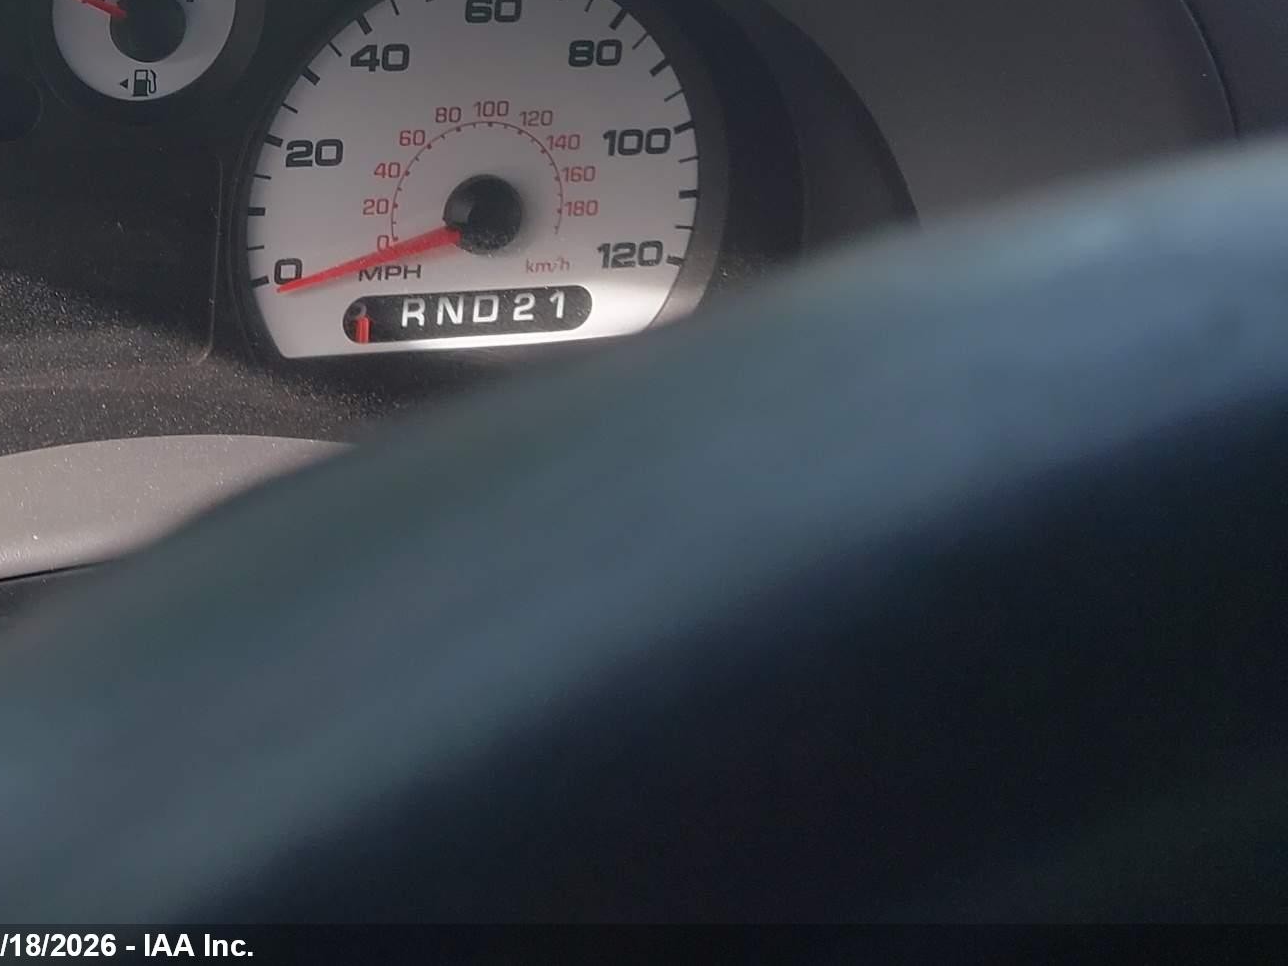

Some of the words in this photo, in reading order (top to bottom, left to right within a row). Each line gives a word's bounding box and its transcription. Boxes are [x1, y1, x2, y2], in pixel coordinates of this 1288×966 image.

[351, 43, 410, 72] 40
[568, 39, 622, 67] 80
[435, 106, 462, 124] 80
[473, 100, 510, 118] 100
[519, 110, 554, 127] 120
[399, 130, 426, 147] 60
[546, 134, 581, 151] 140
[602, 128, 671, 156] 100
[285, 139, 344, 167] 20
[373, 162, 401, 179] 40
[562, 165, 596, 182] 160
[363, 198, 389, 215] 20
[565, 200, 598, 217] 180
[597, 240, 664, 269] 120
[274, 258, 303, 285] 0
[358, 264, 422, 282] MPH
[525, 257, 570, 274] km/h
